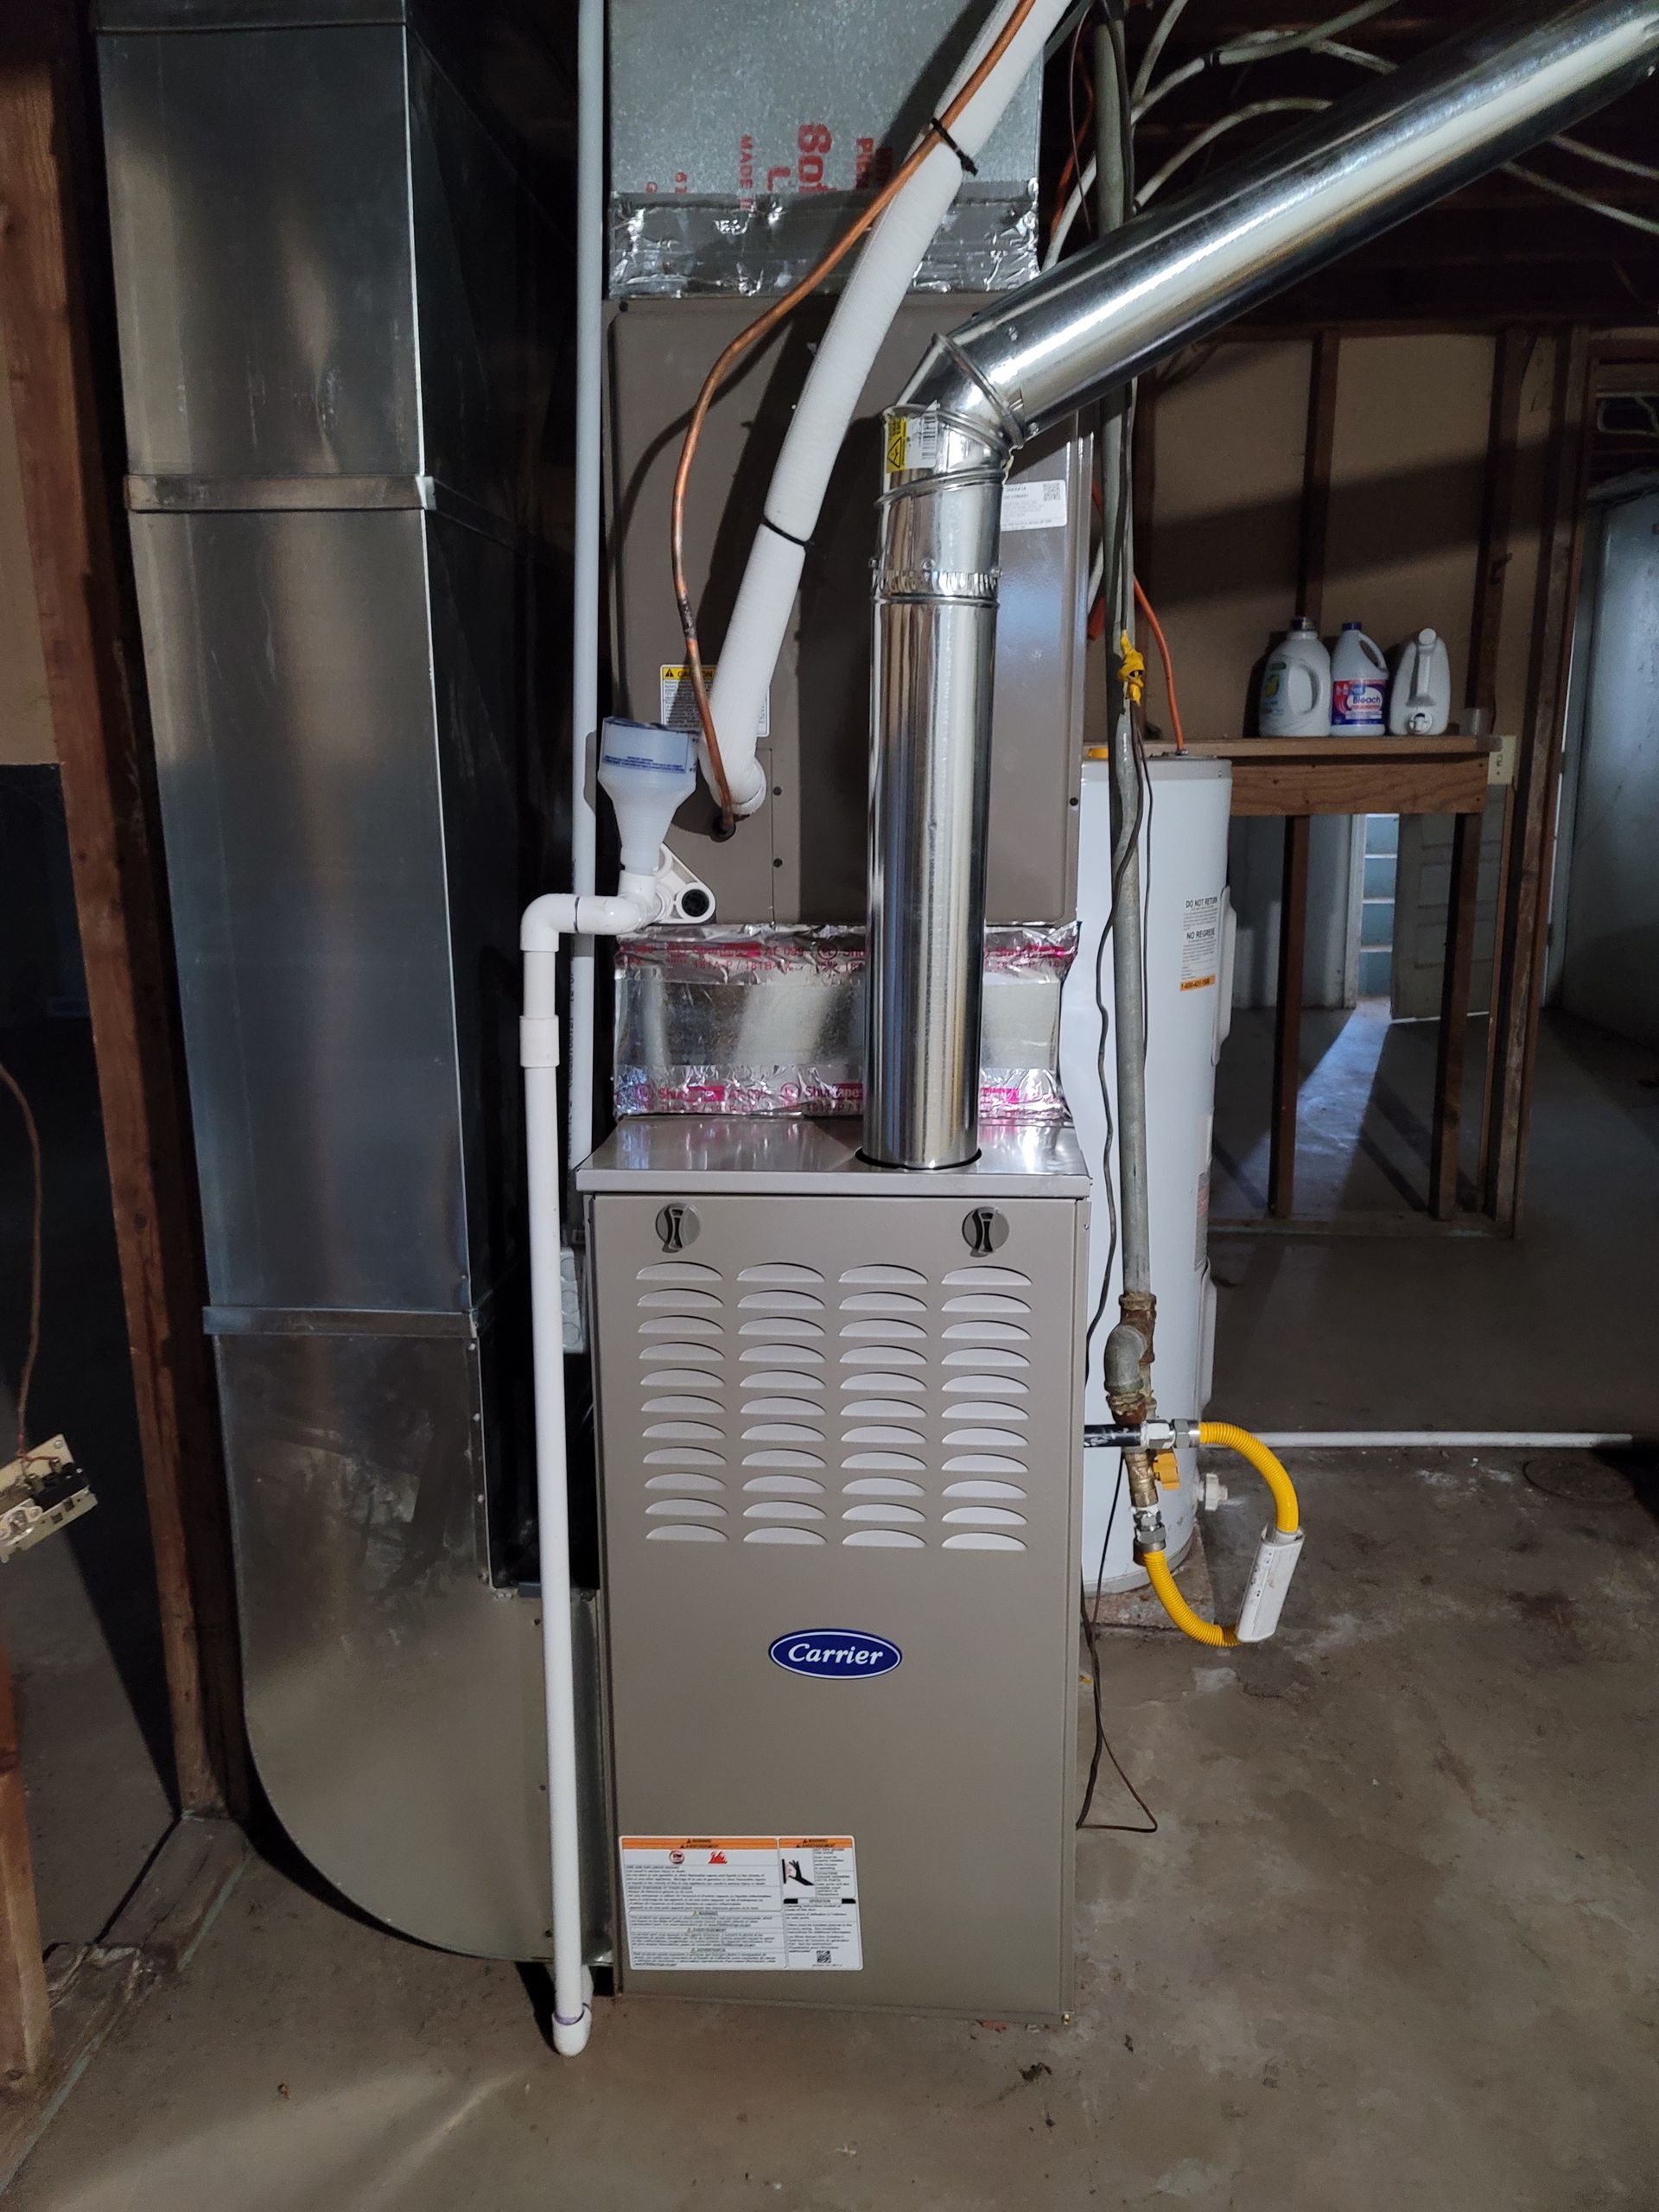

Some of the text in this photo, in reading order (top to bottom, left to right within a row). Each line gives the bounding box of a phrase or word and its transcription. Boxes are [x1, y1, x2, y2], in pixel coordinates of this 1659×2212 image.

[741, 134, 753, 188] MADE
[1353, 695, 1381, 703] Bleach
[1185, 899, 1193, 908] DO
[788, 1643, 883, 1665] Carrier
